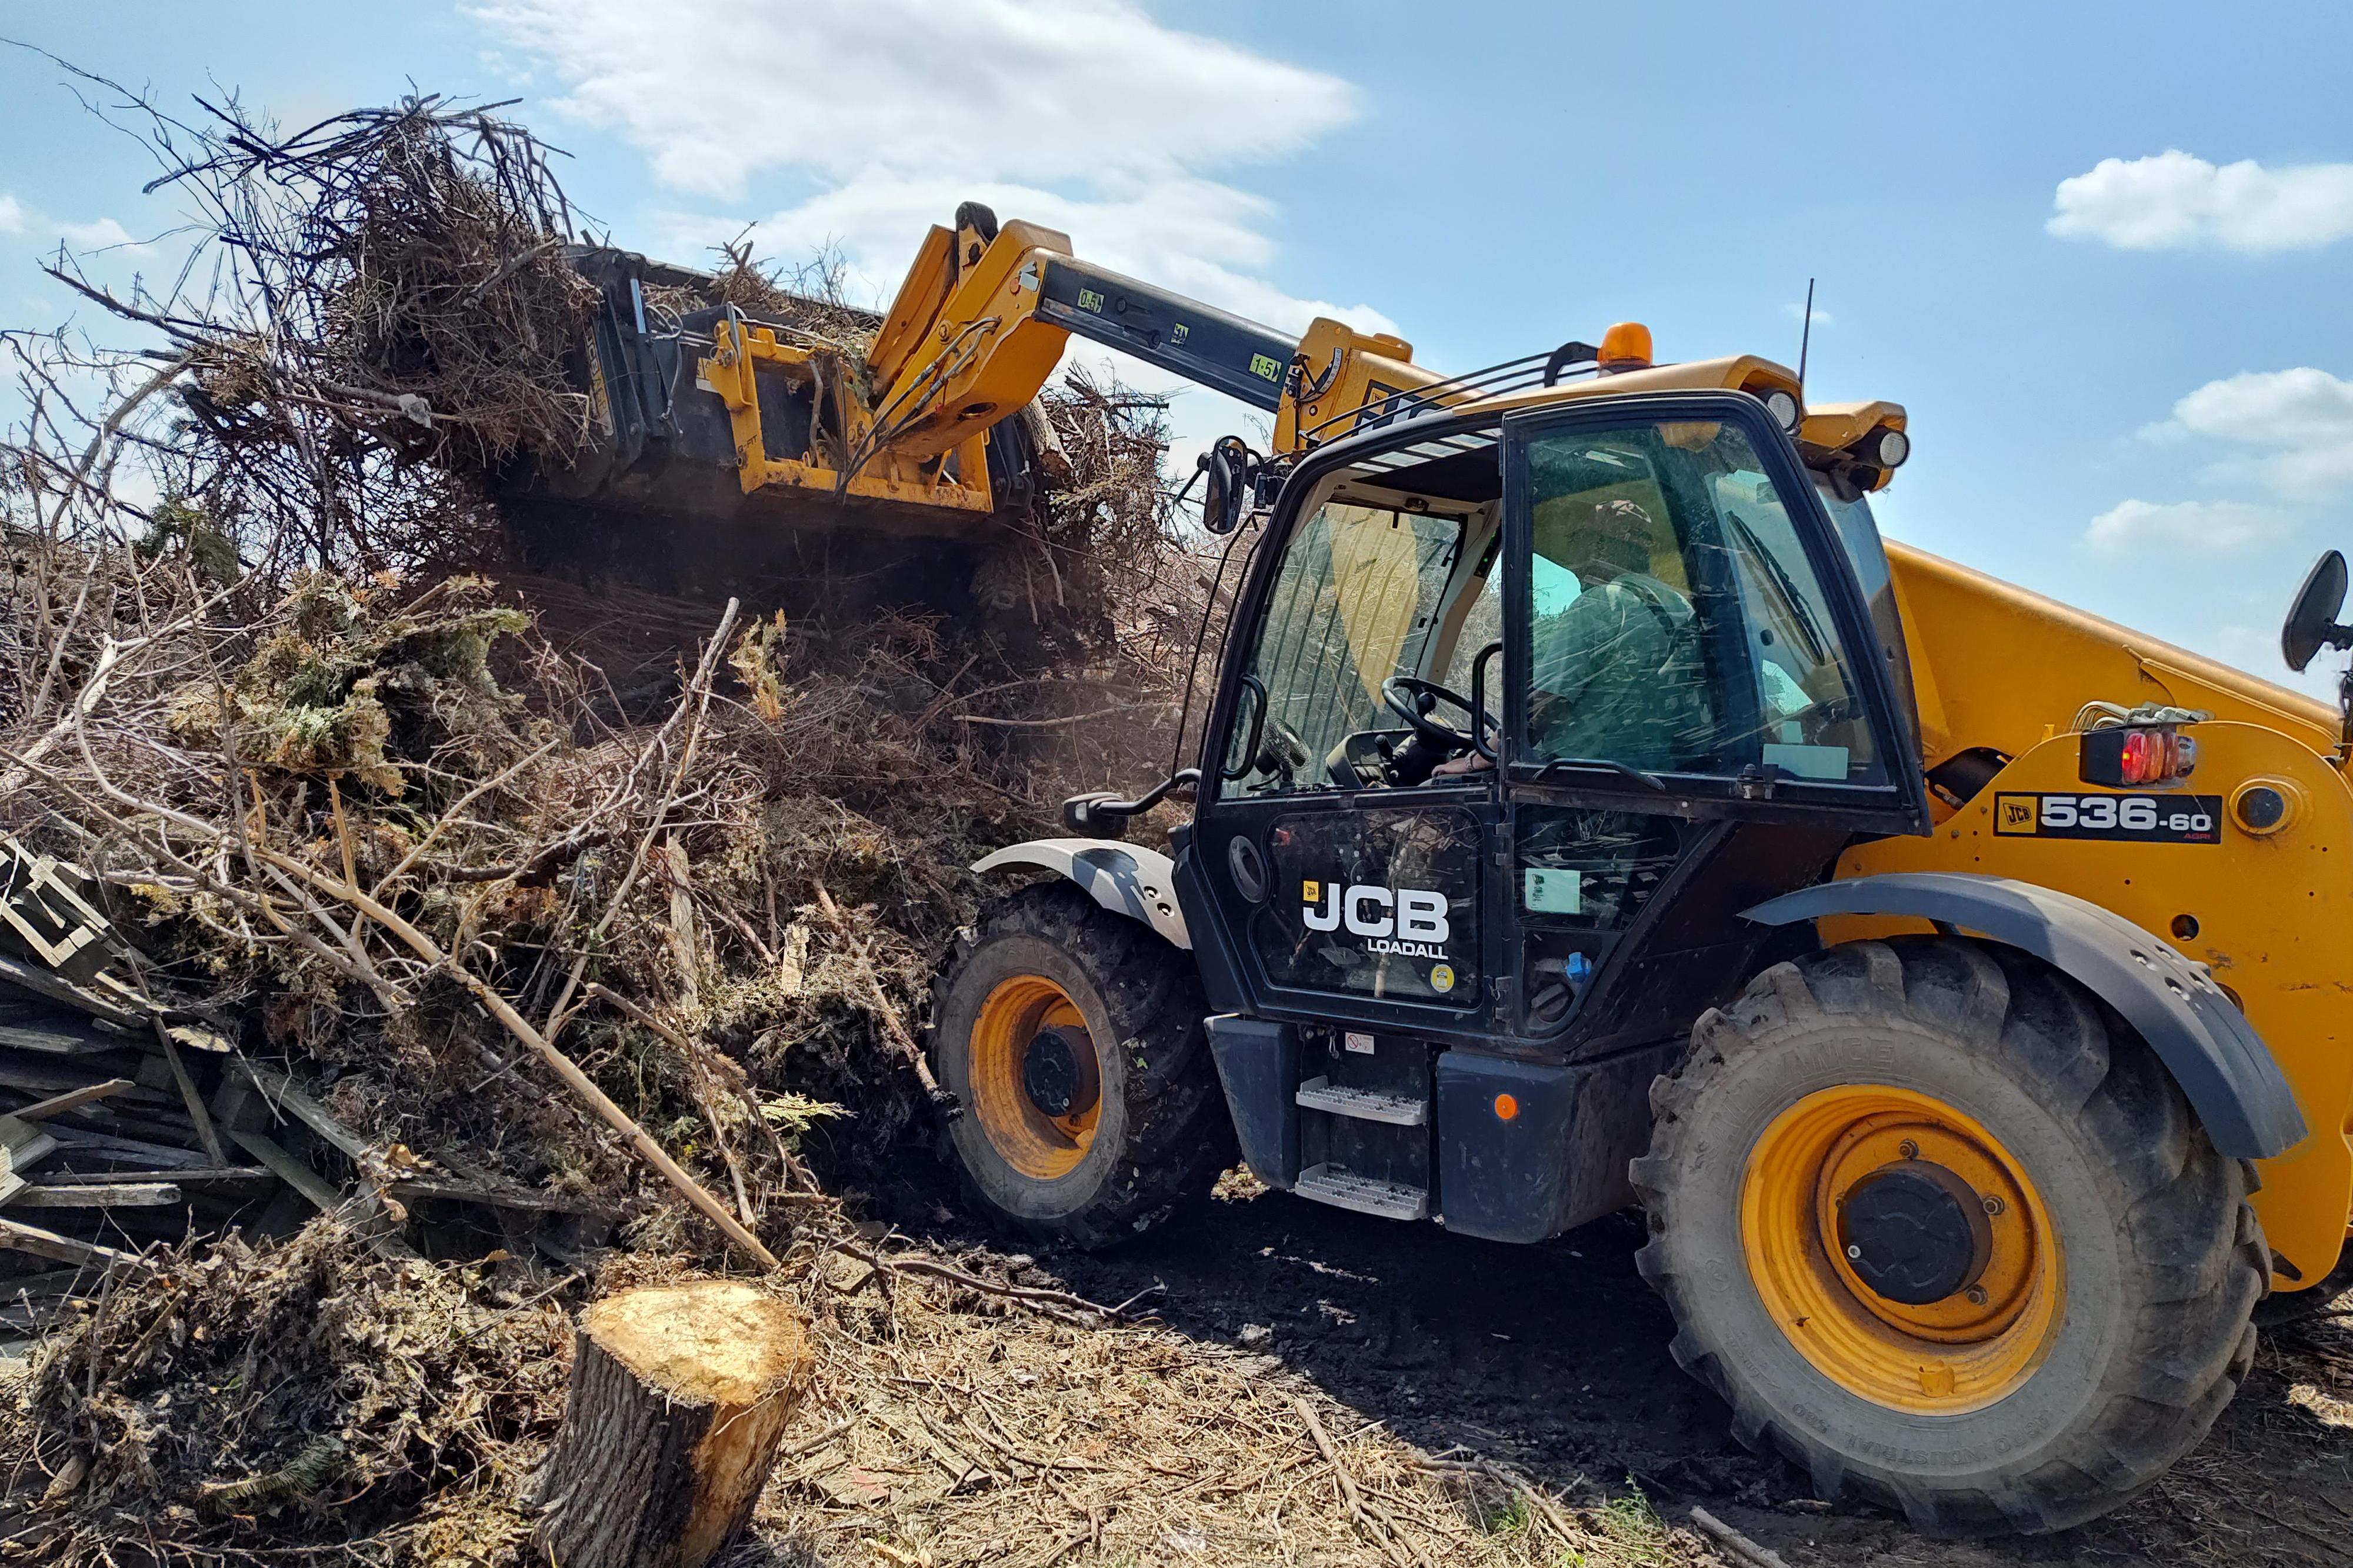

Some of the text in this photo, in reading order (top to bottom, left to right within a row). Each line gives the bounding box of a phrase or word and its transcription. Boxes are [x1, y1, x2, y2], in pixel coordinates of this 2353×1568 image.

[2008, 806, 2031, 823] JCB
[2041, 796, 2211, 831] 536-60
[1303, 882, 1449, 943] JCB
[1368, 939, 1449, 960] LOADALL
